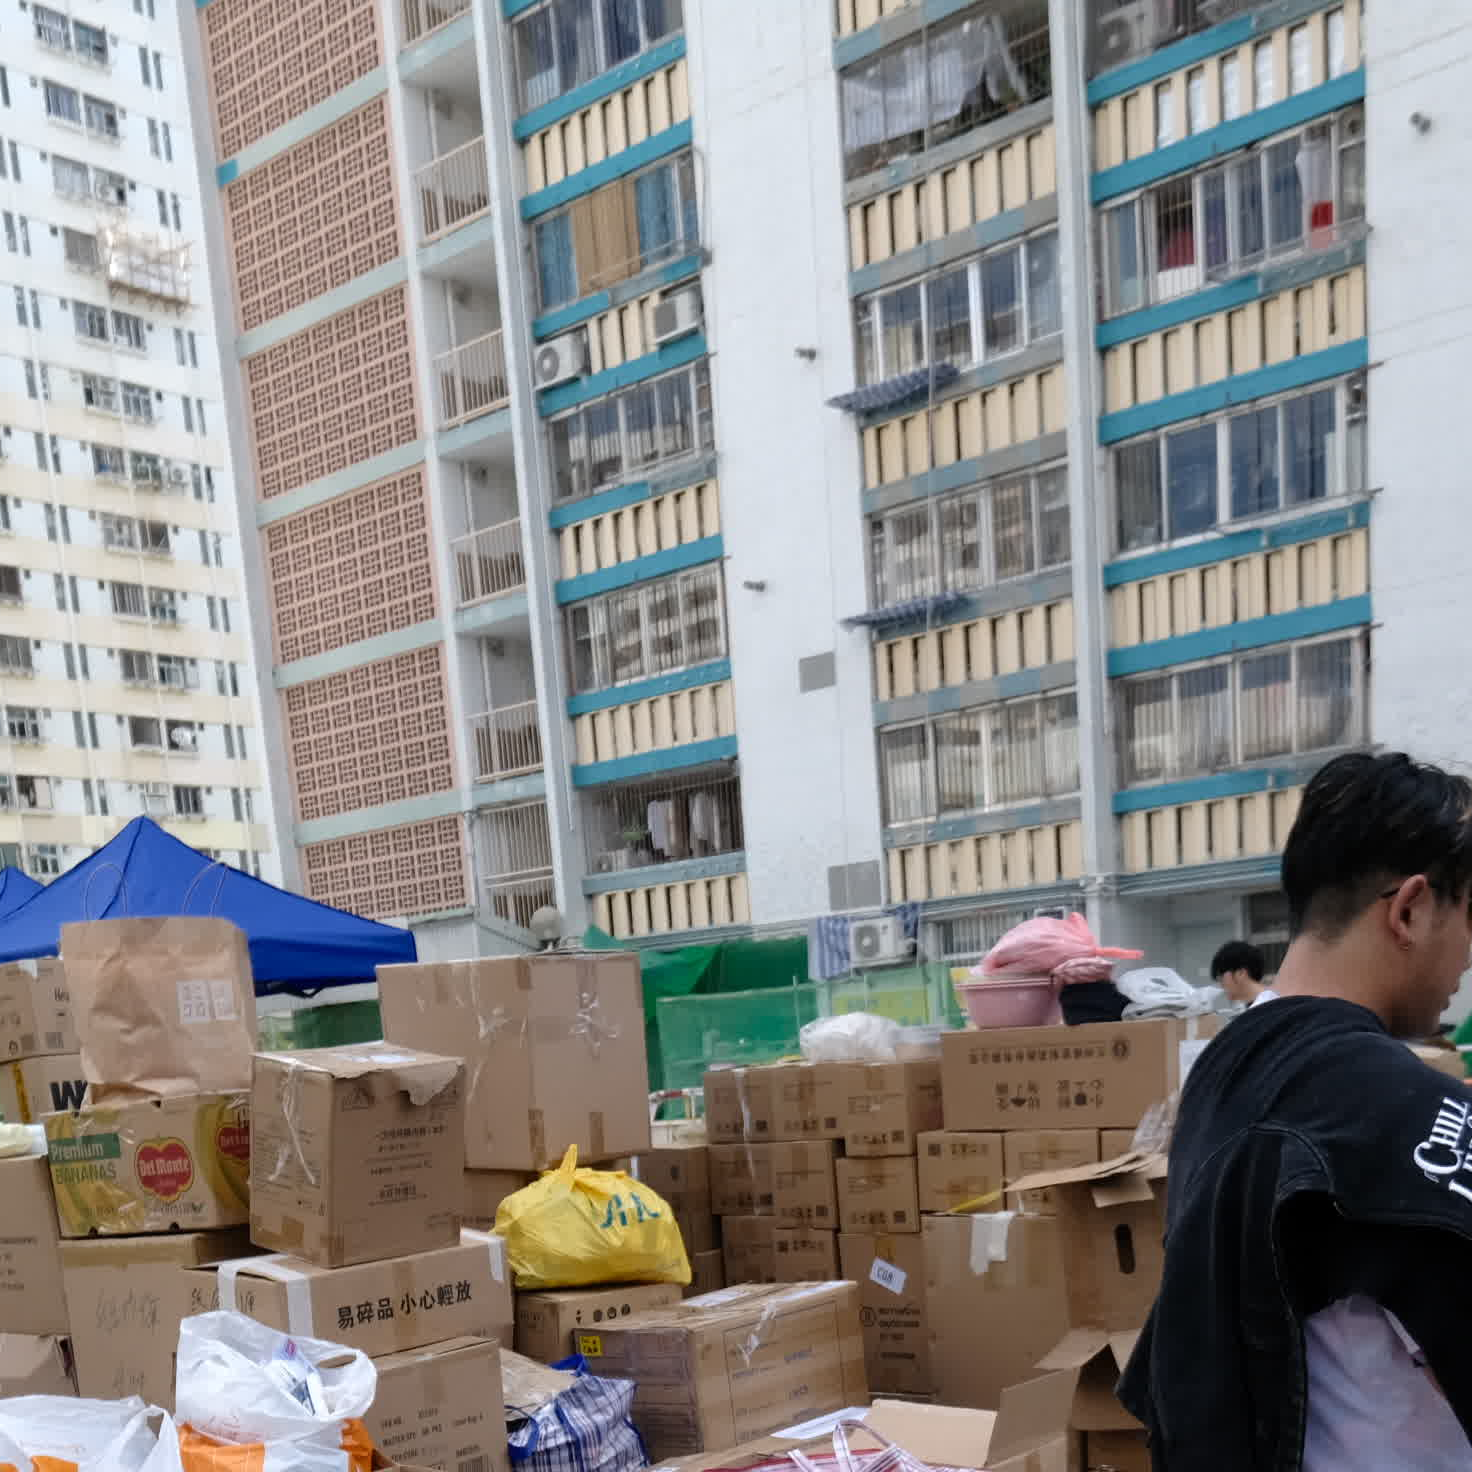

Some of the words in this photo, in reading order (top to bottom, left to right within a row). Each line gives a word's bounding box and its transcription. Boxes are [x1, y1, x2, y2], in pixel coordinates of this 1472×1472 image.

[50, 1142, 104, 1160] Premium
[1414, 1097, 1470, 1174] CHILL
[55, 1164, 117, 1184] BANANAS
[337, 1298, 394, 1330] 易碎品
[400, 1280, 472, 1315] 小心輕放
